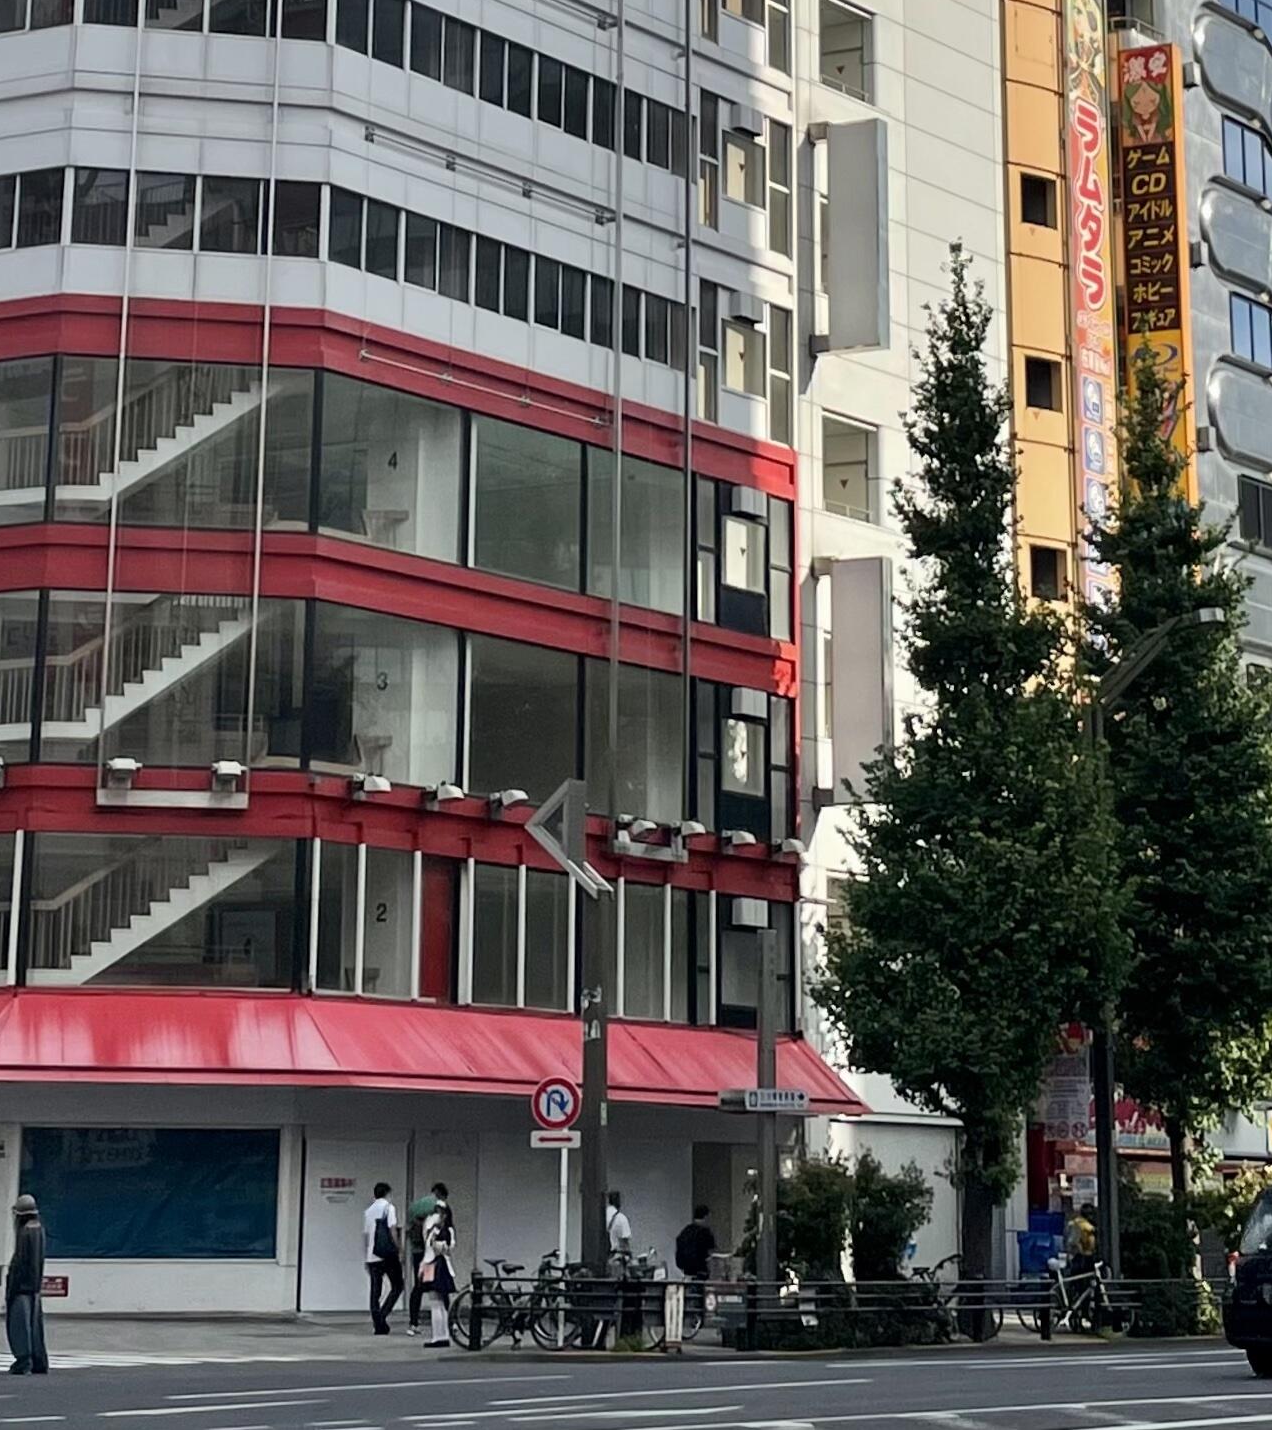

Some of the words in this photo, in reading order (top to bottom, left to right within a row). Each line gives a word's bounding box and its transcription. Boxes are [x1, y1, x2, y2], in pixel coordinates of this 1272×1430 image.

[1123, 51, 1168, 82] 激安
[1127, 146, 1170, 168] ゲーム
[1131, 174, 1166, 194] CD
[1076, 101, 1106, 310] ラムタラ
[1127, 200, 1173, 222] アイドル
[1128, 226, 1175, 250] アニメ
[1130, 254, 1173, 274] コミック
[1133, 280, 1174, 303] ホビー
[387, 451, 399, 471] 4
[377, 672, 389, 690] 3
[375, 903, 388, 923] 2
